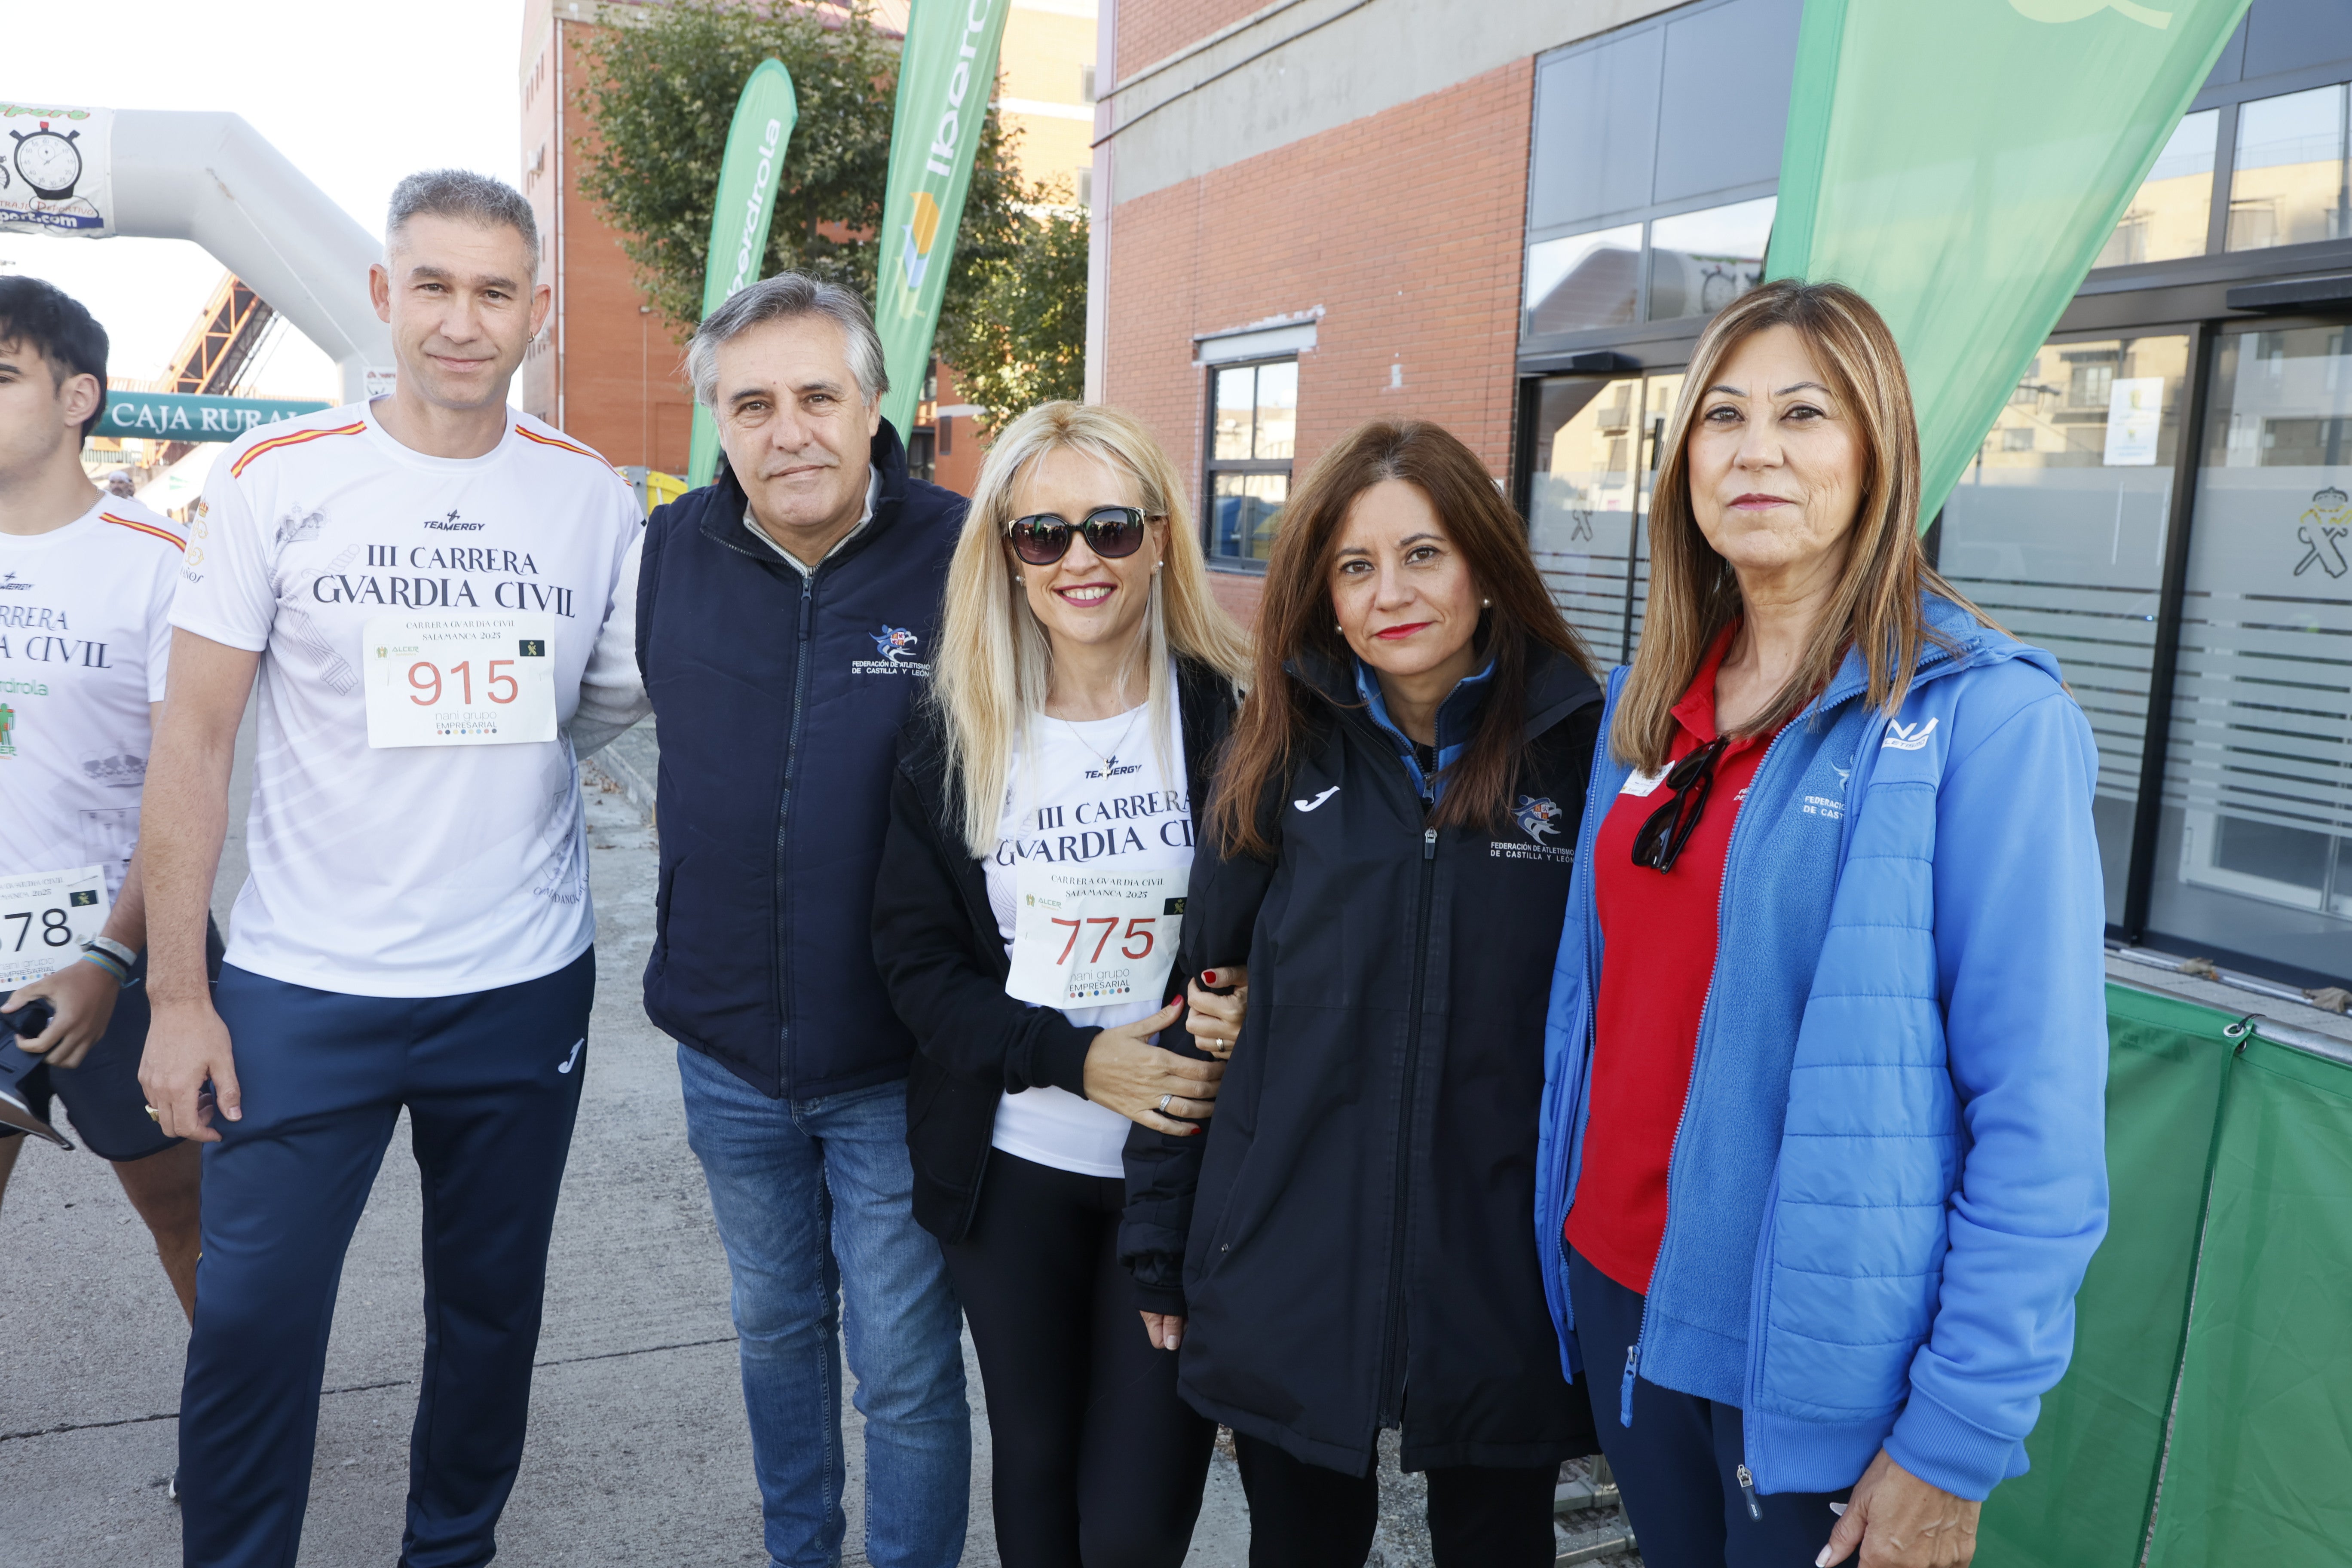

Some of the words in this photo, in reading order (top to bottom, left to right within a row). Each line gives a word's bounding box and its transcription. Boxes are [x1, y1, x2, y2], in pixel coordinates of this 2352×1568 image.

[725, 118, 781, 300] berdrola
[111, 403, 192, 434] CAJA
[424, 521, 485, 531] TEAMERGY
[366, 544, 399, 567] III
[410, 546, 539, 576] CARRERA
[312, 574, 480, 609] GVARDIA
[495, 581, 576, 619] CIVIL
[406, 622, 448, 630] CARRERA
[423, 633, 477, 641] SALAMANCA
[480, 632, 501, 640] 2025
[25, 636, 113, 669] CIVIL
[852, 659, 889, 667] FEDERACIÓN
[900, 662, 930, 670] ATLETISMO
[408, 660, 518, 706] 915
[435, 710, 459, 720] nani
[463, 711, 497, 722] grupo
[436, 721, 497, 729] EMPRESARIAL
[1803, 805, 1818, 814] DE
[1037, 805, 1066, 830] III
[996, 826, 1147, 866] GVARDIA
[1491, 842, 1531, 851] FEDERACIÓN
[1542, 846, 1574, 856] ATLETISMO
[1506, 851, 1543, 860] CASTILLA
[1556, 854, 1575, 864] LEÓN
[1051, 875, 1094, 885] CARRERA
[32, 888, 52, 897] 2025
[1066, 889, 1122, 898] SALAMANCA
[1038, 897, 1062, 909] ALCER
[0, 908, 72, 952] 78
[1051, 916, 1156, 966] 775
[1070, 970, 1093, 983] nani
[1097, 968, 1130, 982] grupo
[1069, 979, 1130, 992] EMPRESARIAL
